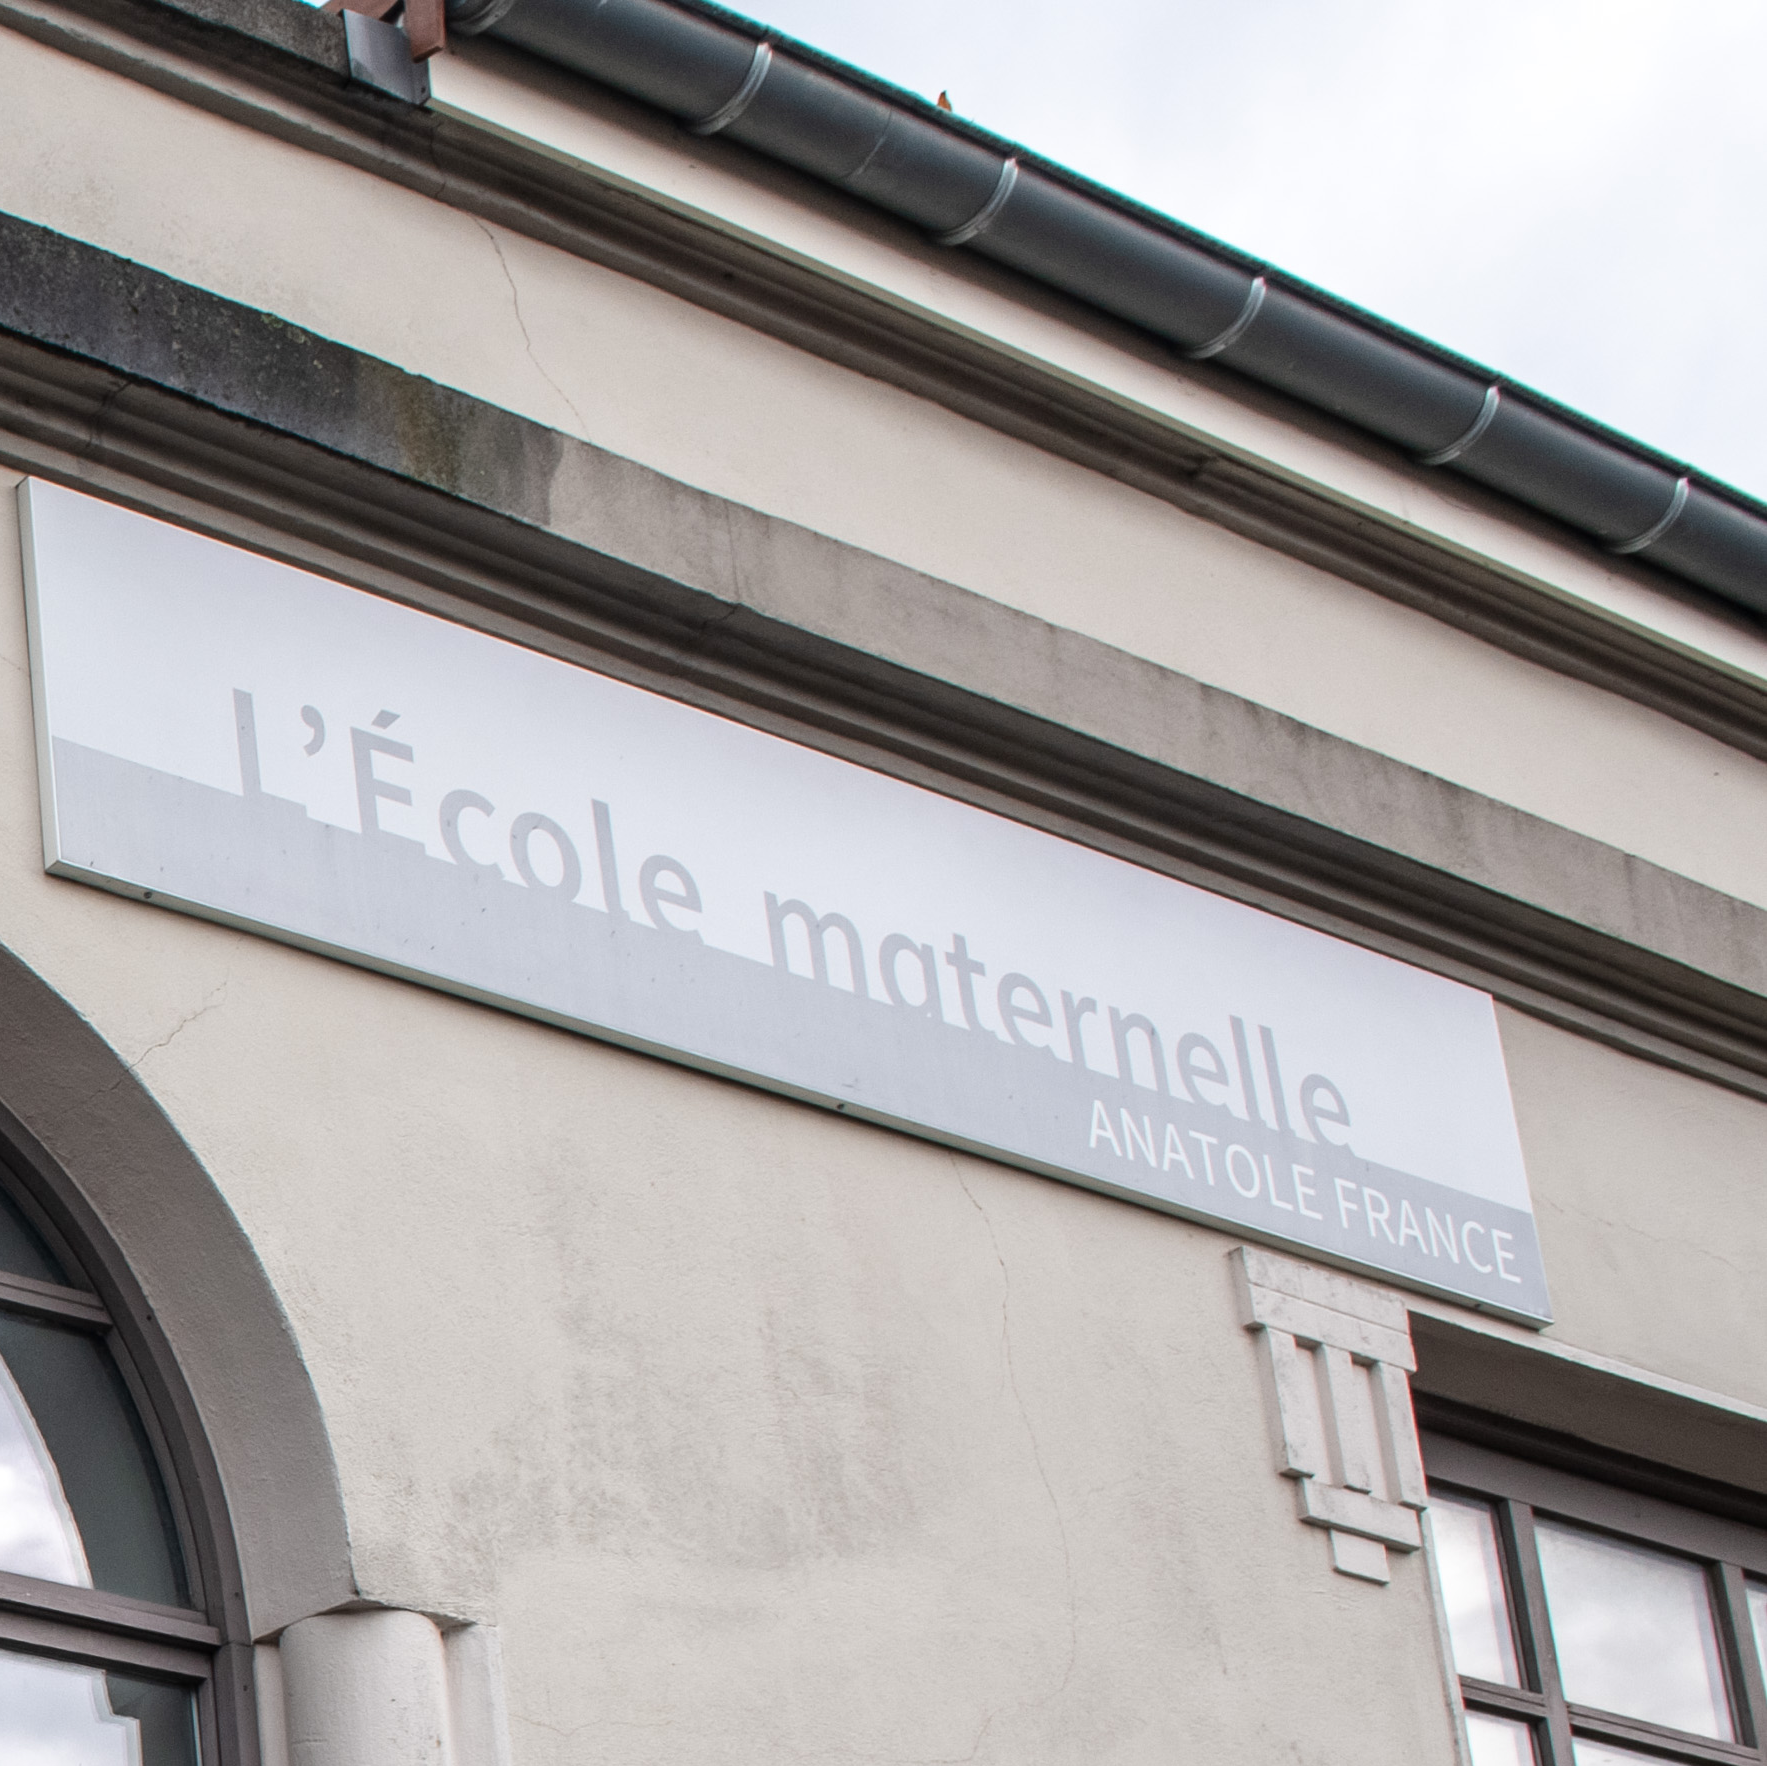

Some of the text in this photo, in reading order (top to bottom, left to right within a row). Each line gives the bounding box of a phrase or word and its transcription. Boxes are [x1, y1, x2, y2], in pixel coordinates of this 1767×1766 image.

[232, 687, 1357, 1156] L'École maternelle
[1088, 1098, 1523, 1285] ANATOLE FRANCE
